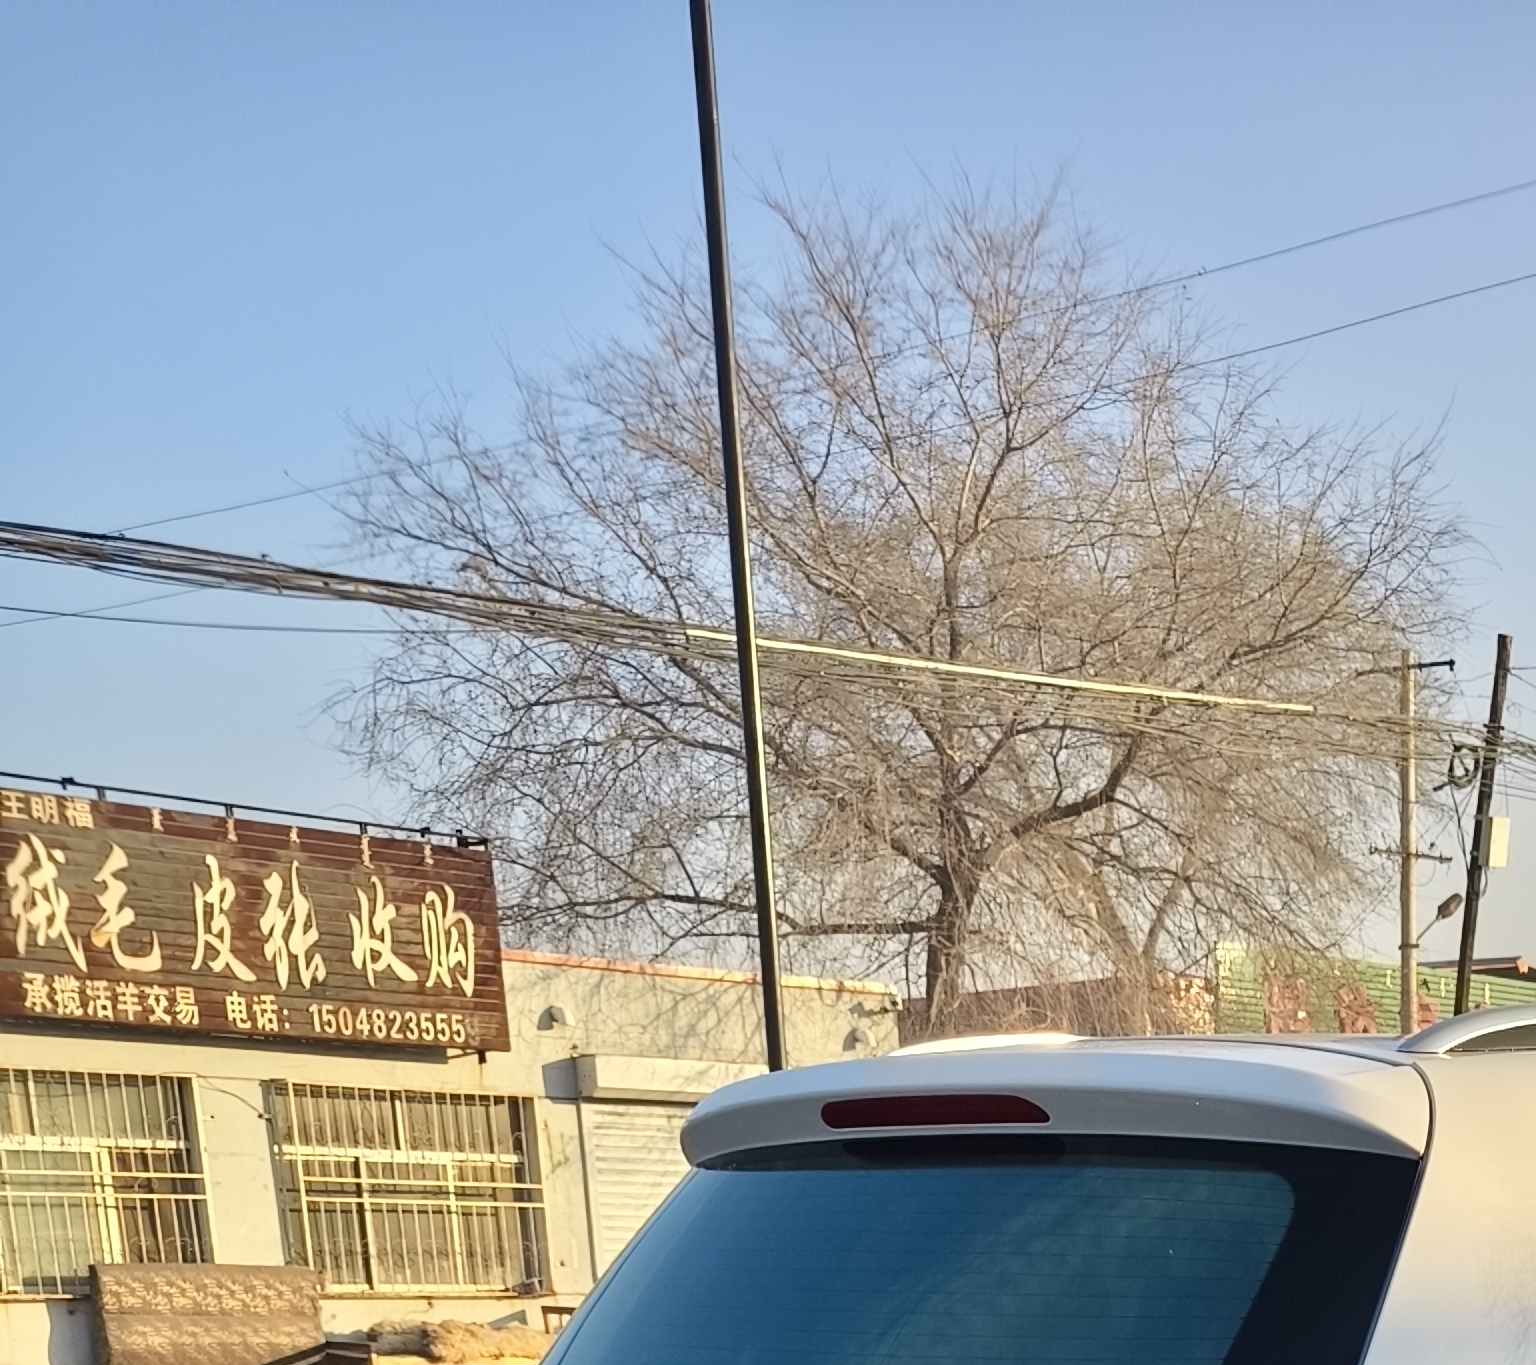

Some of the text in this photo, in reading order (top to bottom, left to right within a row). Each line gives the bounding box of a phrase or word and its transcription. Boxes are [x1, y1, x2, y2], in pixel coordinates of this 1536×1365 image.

[22, 971, 199, 1026] 承揽活羊交易
